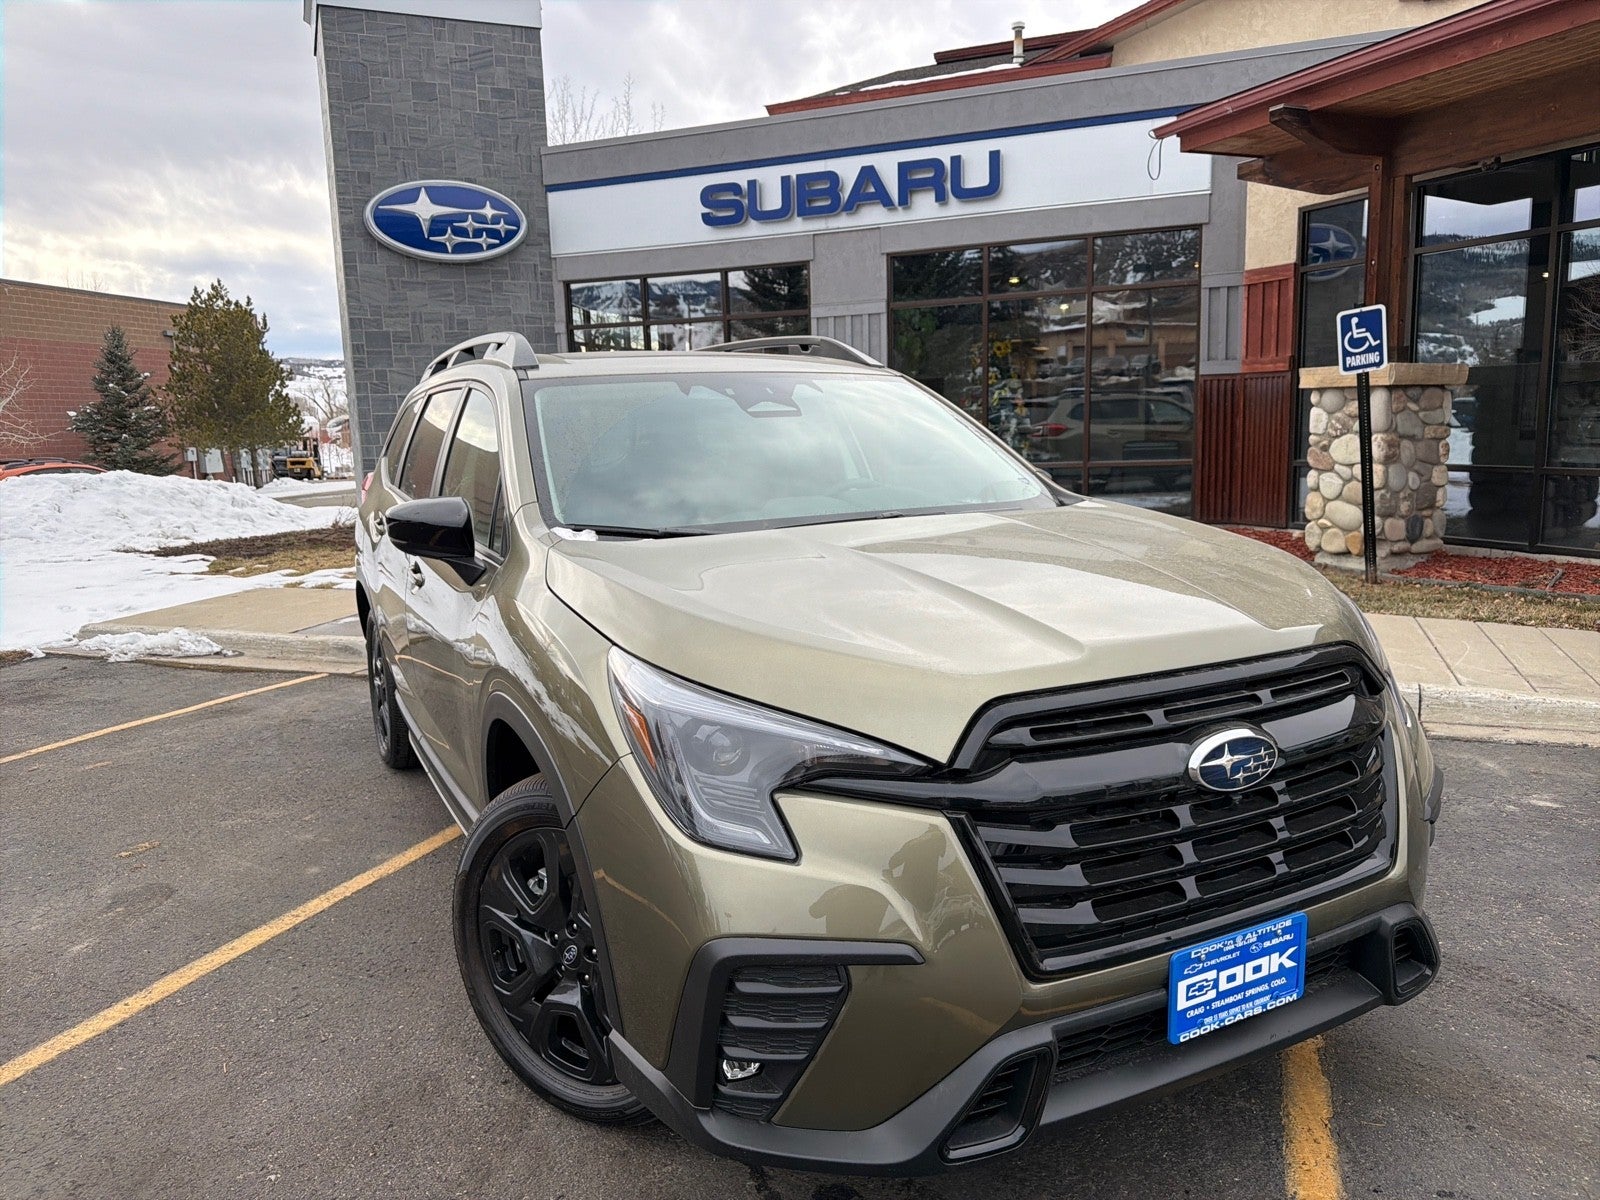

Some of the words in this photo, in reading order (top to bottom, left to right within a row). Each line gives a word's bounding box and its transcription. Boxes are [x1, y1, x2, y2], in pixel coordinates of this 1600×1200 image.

[700, 150, 1001, 228] SUBARU
[1346, 351, 1380, 368] PARKING
[1245, 919, 1293, 939] ALTITUDE
[1263, 933, 1294, 948] SUBARU
[1204, 951, 1240, 967] CHEVROLET
[1177, 946, 1299, 1012] COOK
[1186, 1005, 1205, 1018] CRAIG
[1211, 992, 1244, 1009] STEAMBOAT
[1180, 993, 1298, 1043] COOK-CARS.COM
